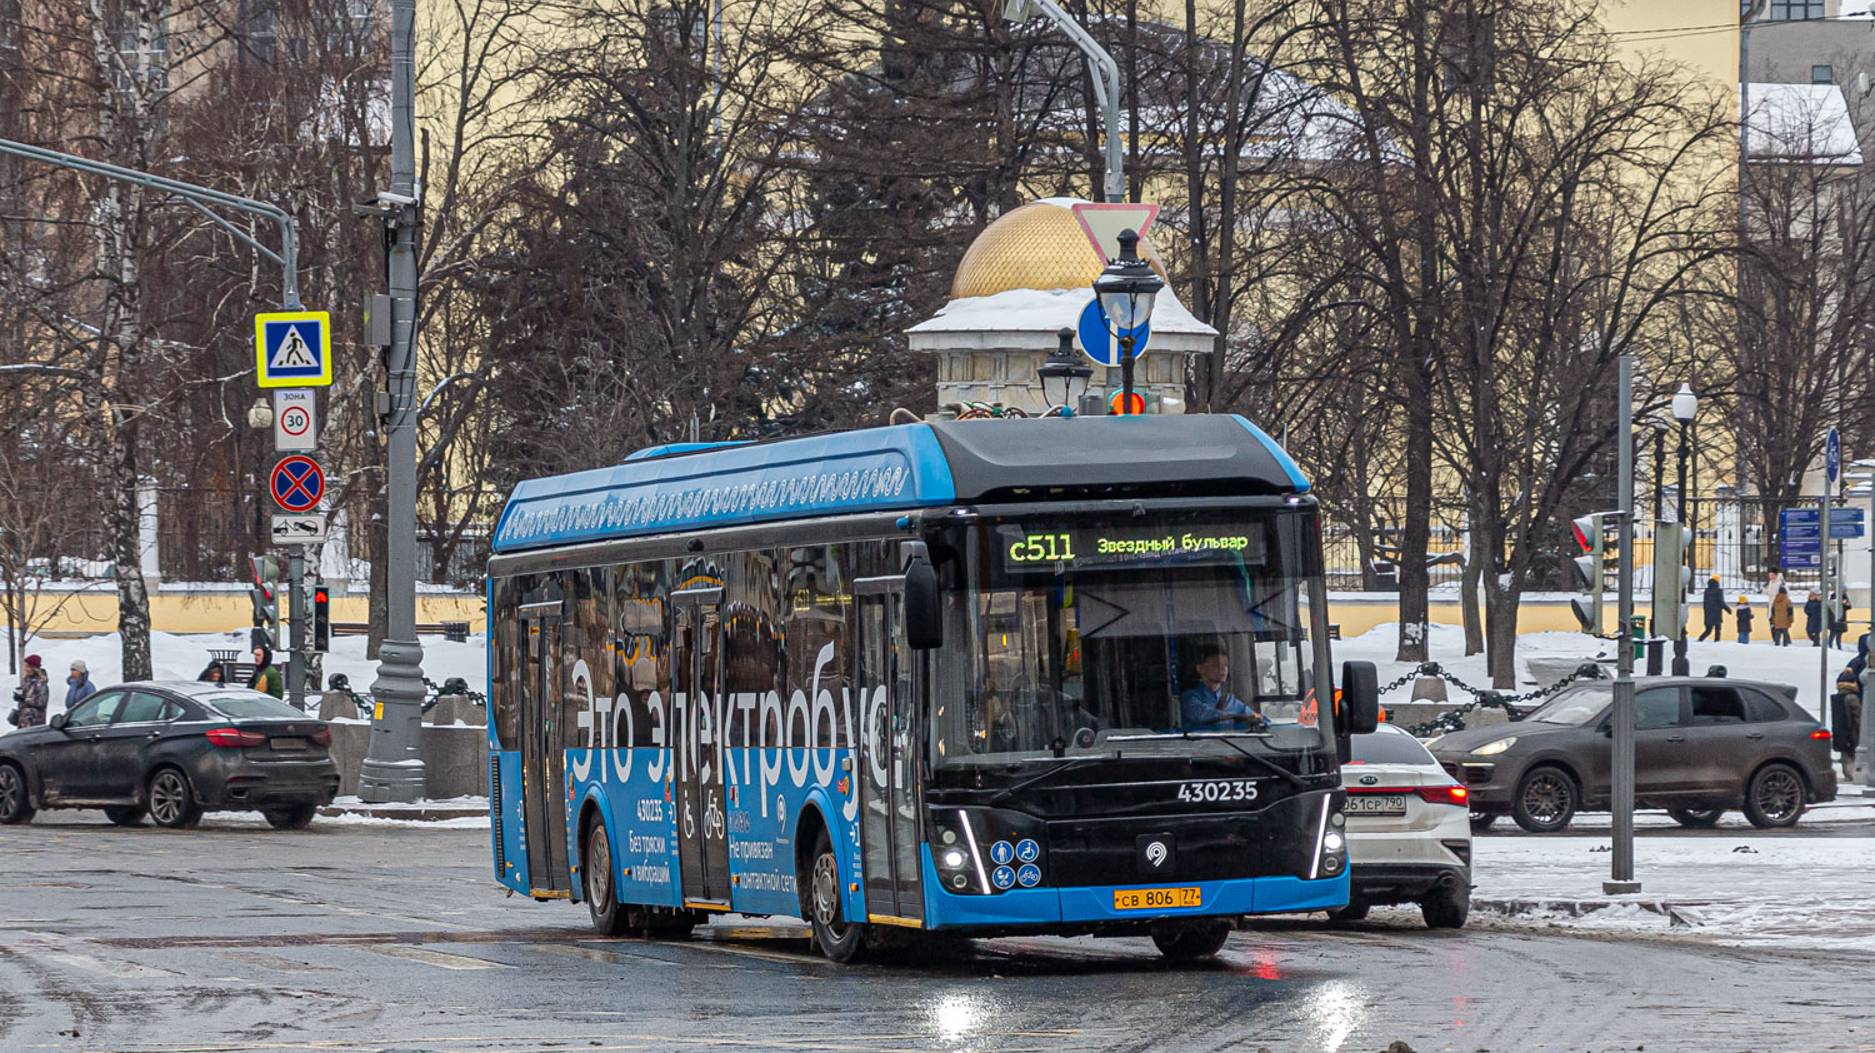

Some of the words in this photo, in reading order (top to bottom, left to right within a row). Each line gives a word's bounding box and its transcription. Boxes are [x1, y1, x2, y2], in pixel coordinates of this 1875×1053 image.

[283, 393, 306, 401] ЗОНА
[287, 415, 304, 427] 30
[1009, 533, 1076, 562] с511
[1097, 538, 1175, 552] Звездный
[1181, 533, 1249, 552] бульвар
[571, 658, 635, 785] Это
[1177, 781, 1258, 803] 430235
[1385, 797, 1403, 808] 790
[637, 799, 663, 821] 430235
[629, 829, 642, 854] Без
[728, 834, 740, 859] Не
[740, 841, 774, 864] привязан
[1121, 895, 1139, 907] СВ
[1145, 891, 1174, 906] 806
[1182, 888, 1196, 900] 77
